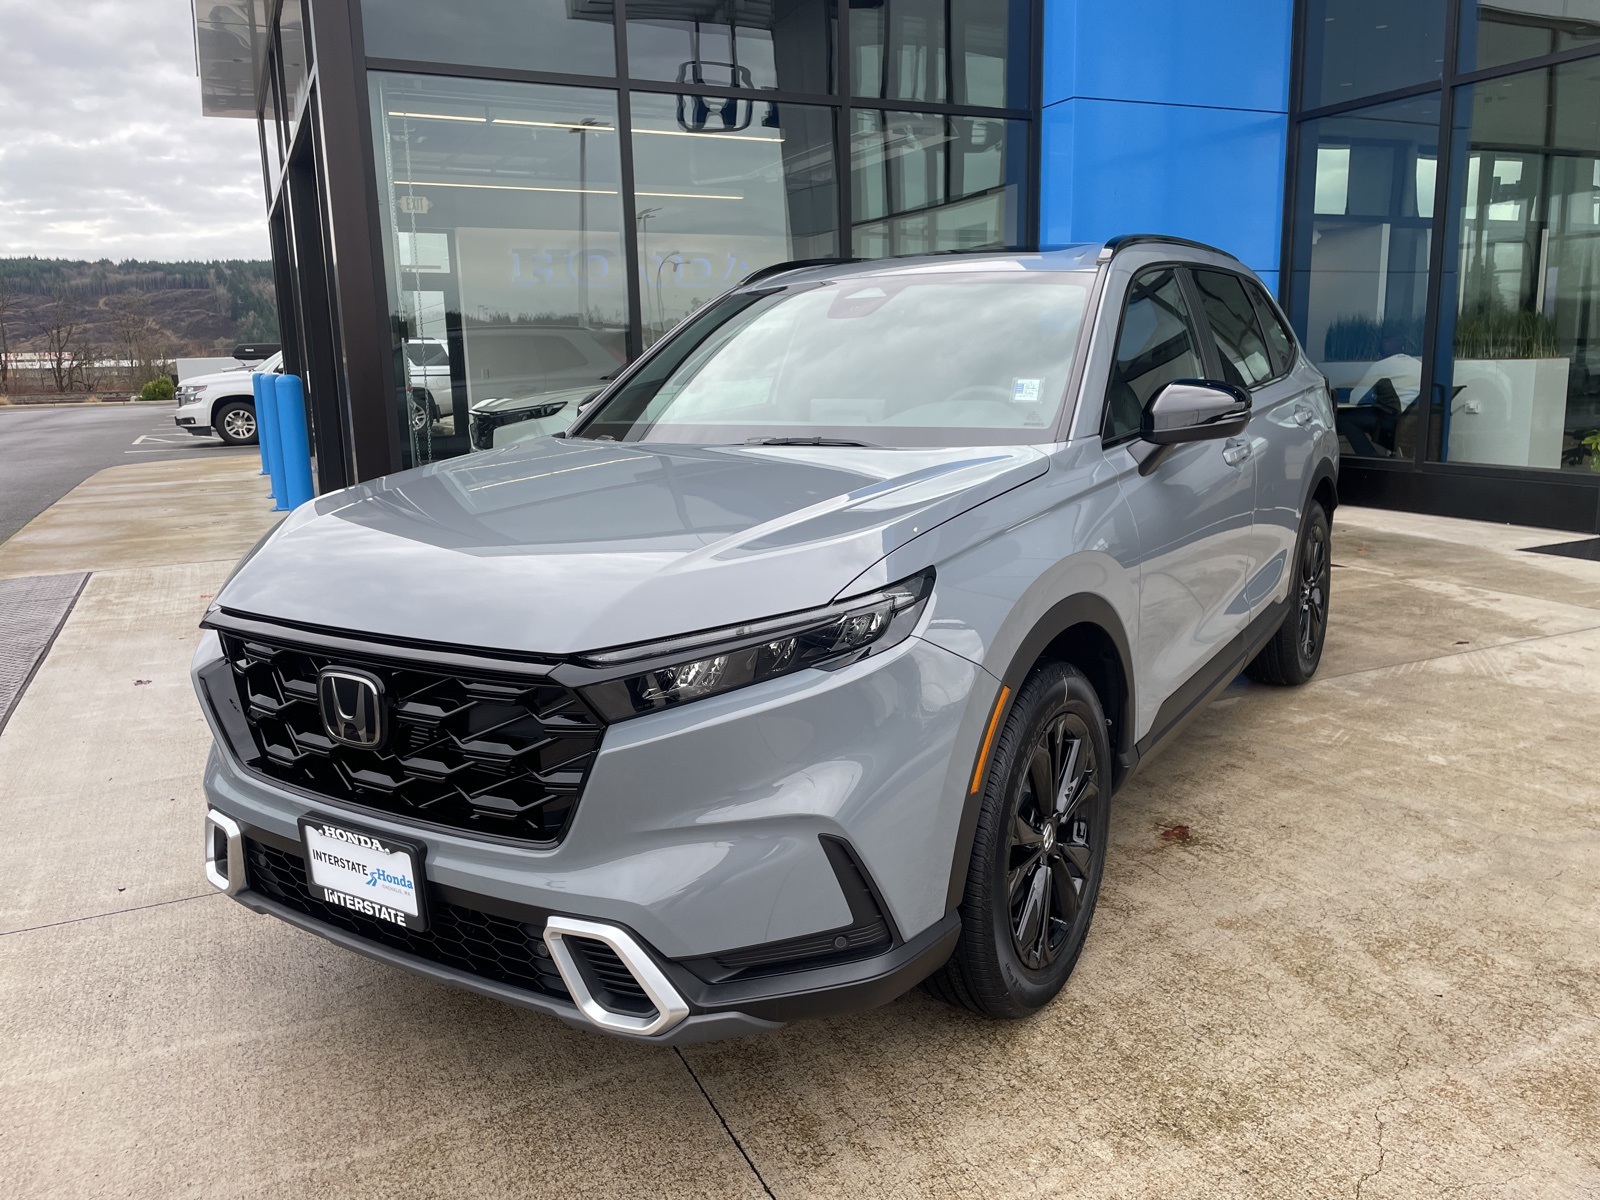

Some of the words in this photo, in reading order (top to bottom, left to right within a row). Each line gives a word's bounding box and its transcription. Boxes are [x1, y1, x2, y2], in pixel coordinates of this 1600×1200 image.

[406, 198, 424, 211] EXIT
[322, 825, 384, 854] HONDA
[312, 848, 368, 876] INTERSTATE
[376, 868, 413, 889] Honda
[324, 888, 407, 927] INTERSTATE
